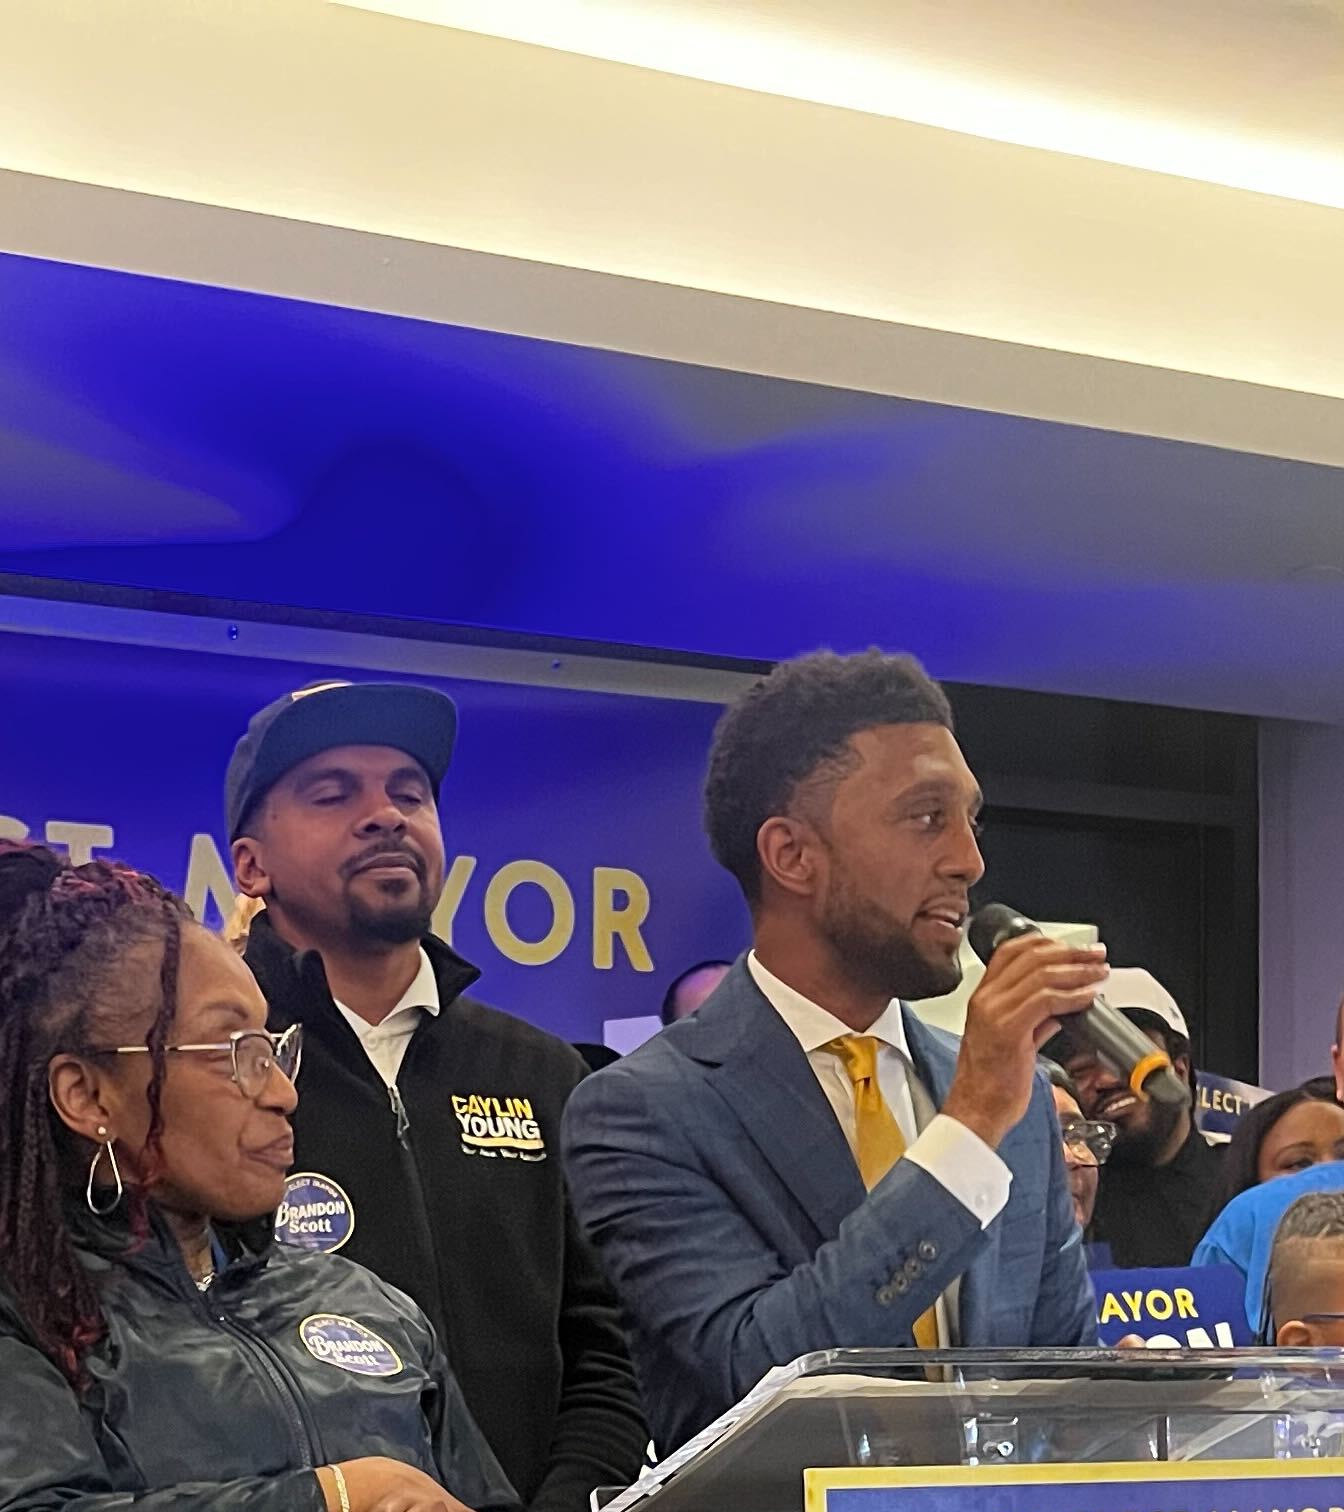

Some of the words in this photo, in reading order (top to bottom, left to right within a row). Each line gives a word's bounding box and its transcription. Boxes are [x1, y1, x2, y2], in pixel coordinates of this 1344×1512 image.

[452, 1094, 533, 1120] CAYLIN
[456, 1112, 541, 1140] YOUNG
[275, 1201, 346, 1228] BRANDON
[289, 1219, 332, 1234] Scott
[1097, 1288, 1199, 1324] AYOR
